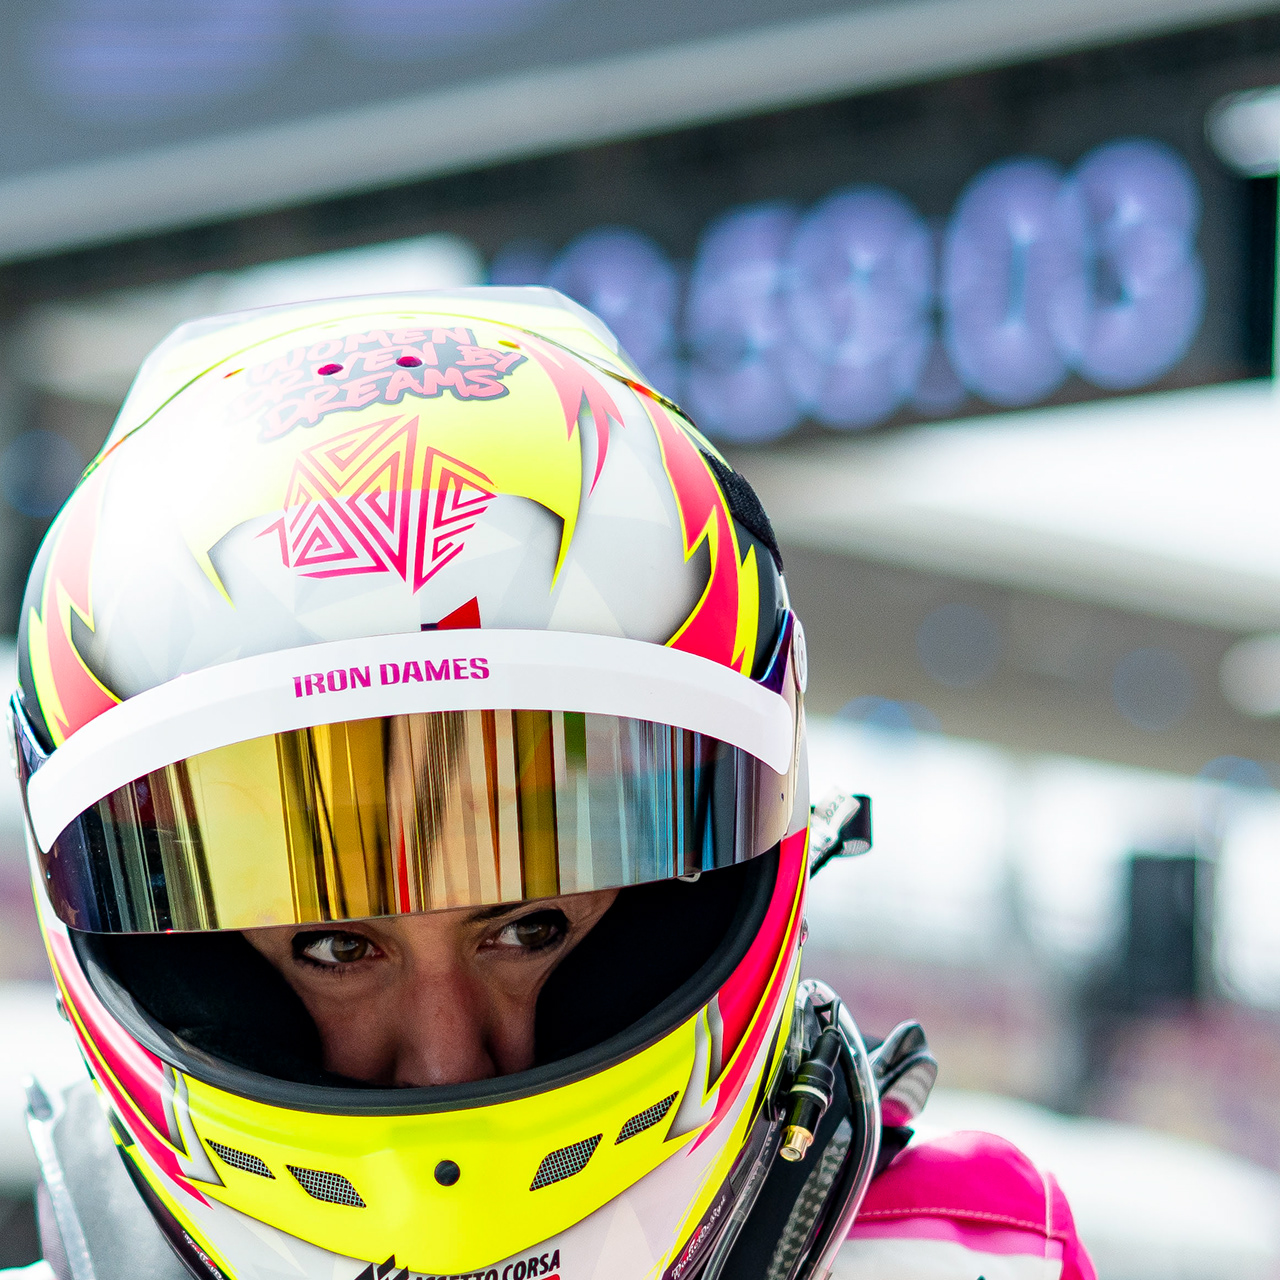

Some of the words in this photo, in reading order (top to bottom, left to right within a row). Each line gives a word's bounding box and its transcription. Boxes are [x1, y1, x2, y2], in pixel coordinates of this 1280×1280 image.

[252, 328, 469, 383] WOMEN
[456, 345, 521, 372] BY
[263, 367, 505, 438] DREAMS
[293, 666, 371, 698] IRON
[379, 657, 490, 686] DAMES
